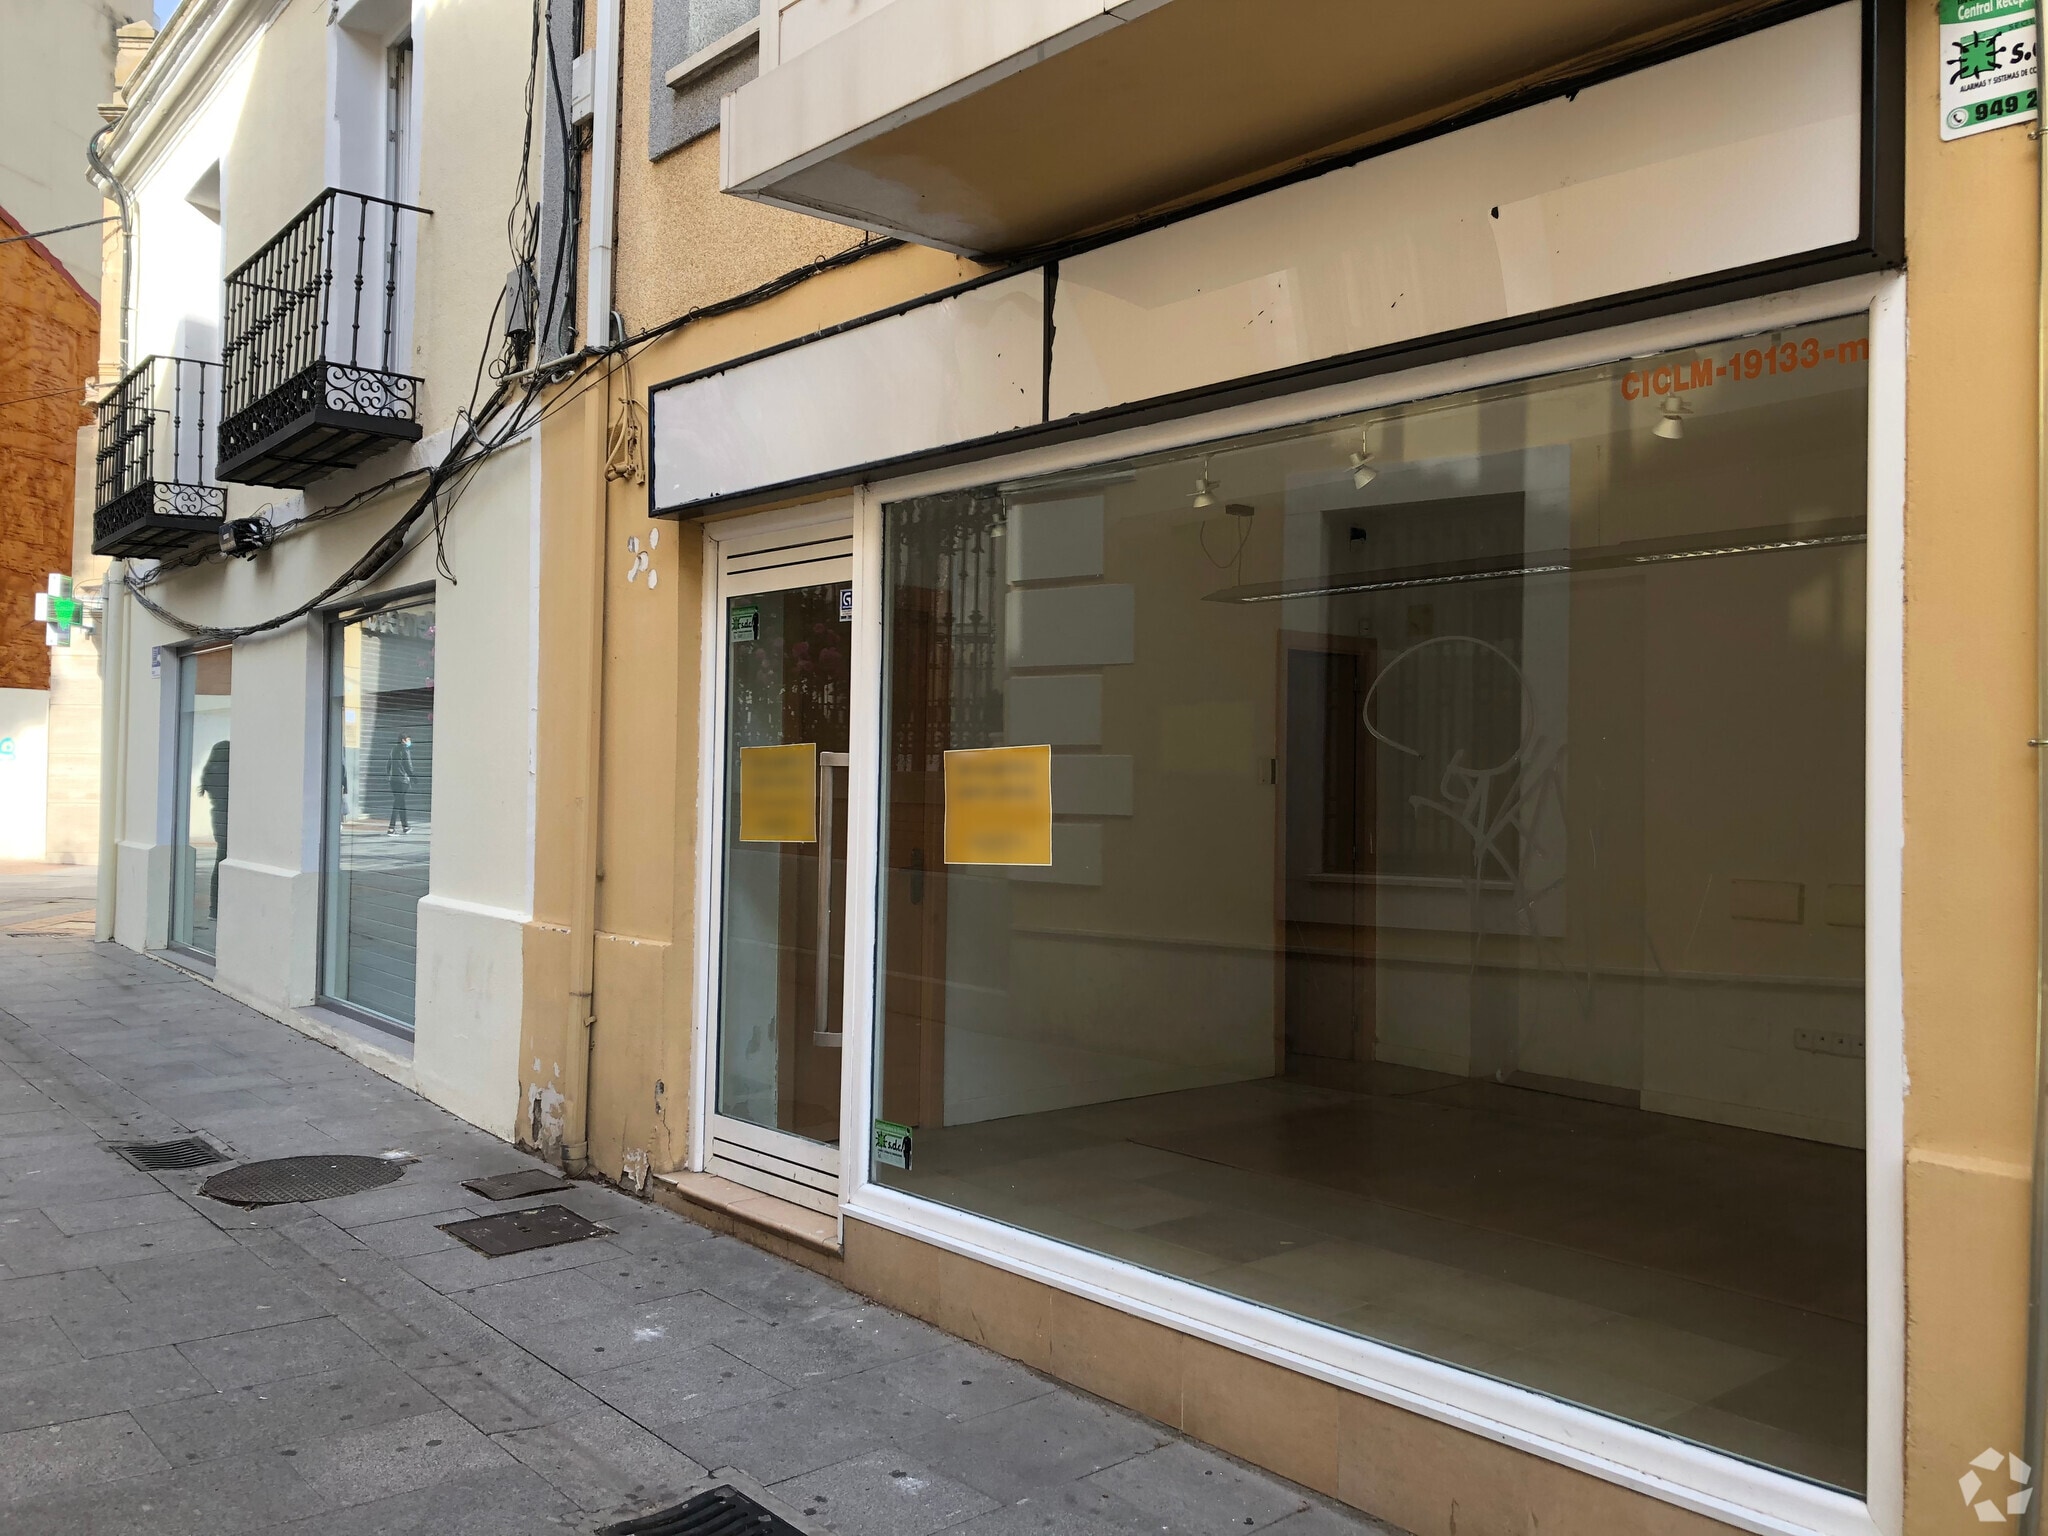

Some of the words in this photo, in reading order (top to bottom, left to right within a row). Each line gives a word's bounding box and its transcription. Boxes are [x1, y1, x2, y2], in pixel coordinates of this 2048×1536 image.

[1957, 0, 1993, 20] Central
[1960, 80, 1986, 92] ALARMAS
[1993, 71, 2019, 84] SISTEMAS
[2021, 69, 2028, 77] DE
[1975, 96, 2018, 121] 949
